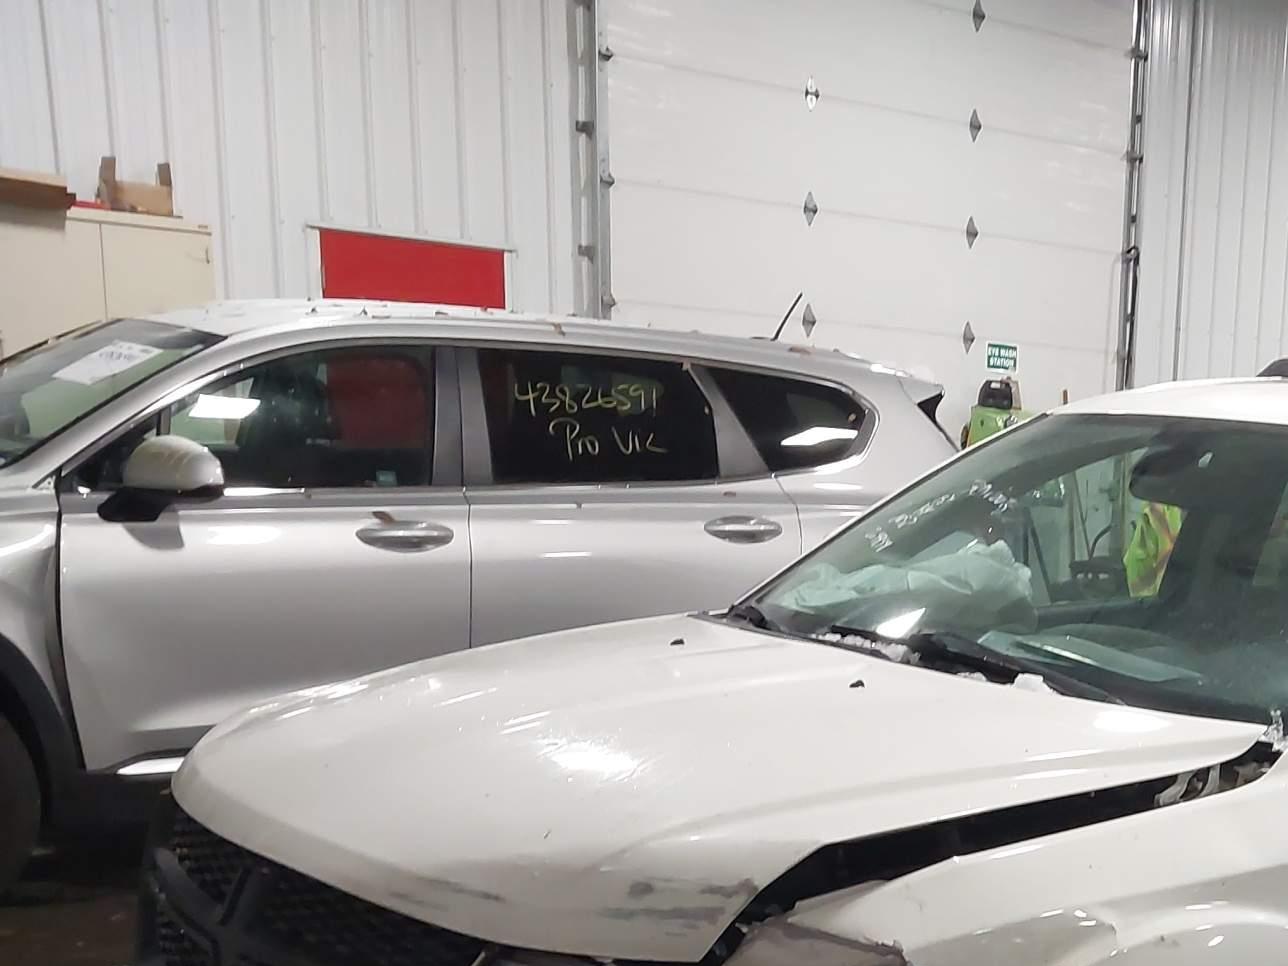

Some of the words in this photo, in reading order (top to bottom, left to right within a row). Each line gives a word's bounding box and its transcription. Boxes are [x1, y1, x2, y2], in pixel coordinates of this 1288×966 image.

[987, 346, 1000, 357] EYE
[1000, 347, 1017, 359] WASH
[989, 357, 1015, 368] STATION
